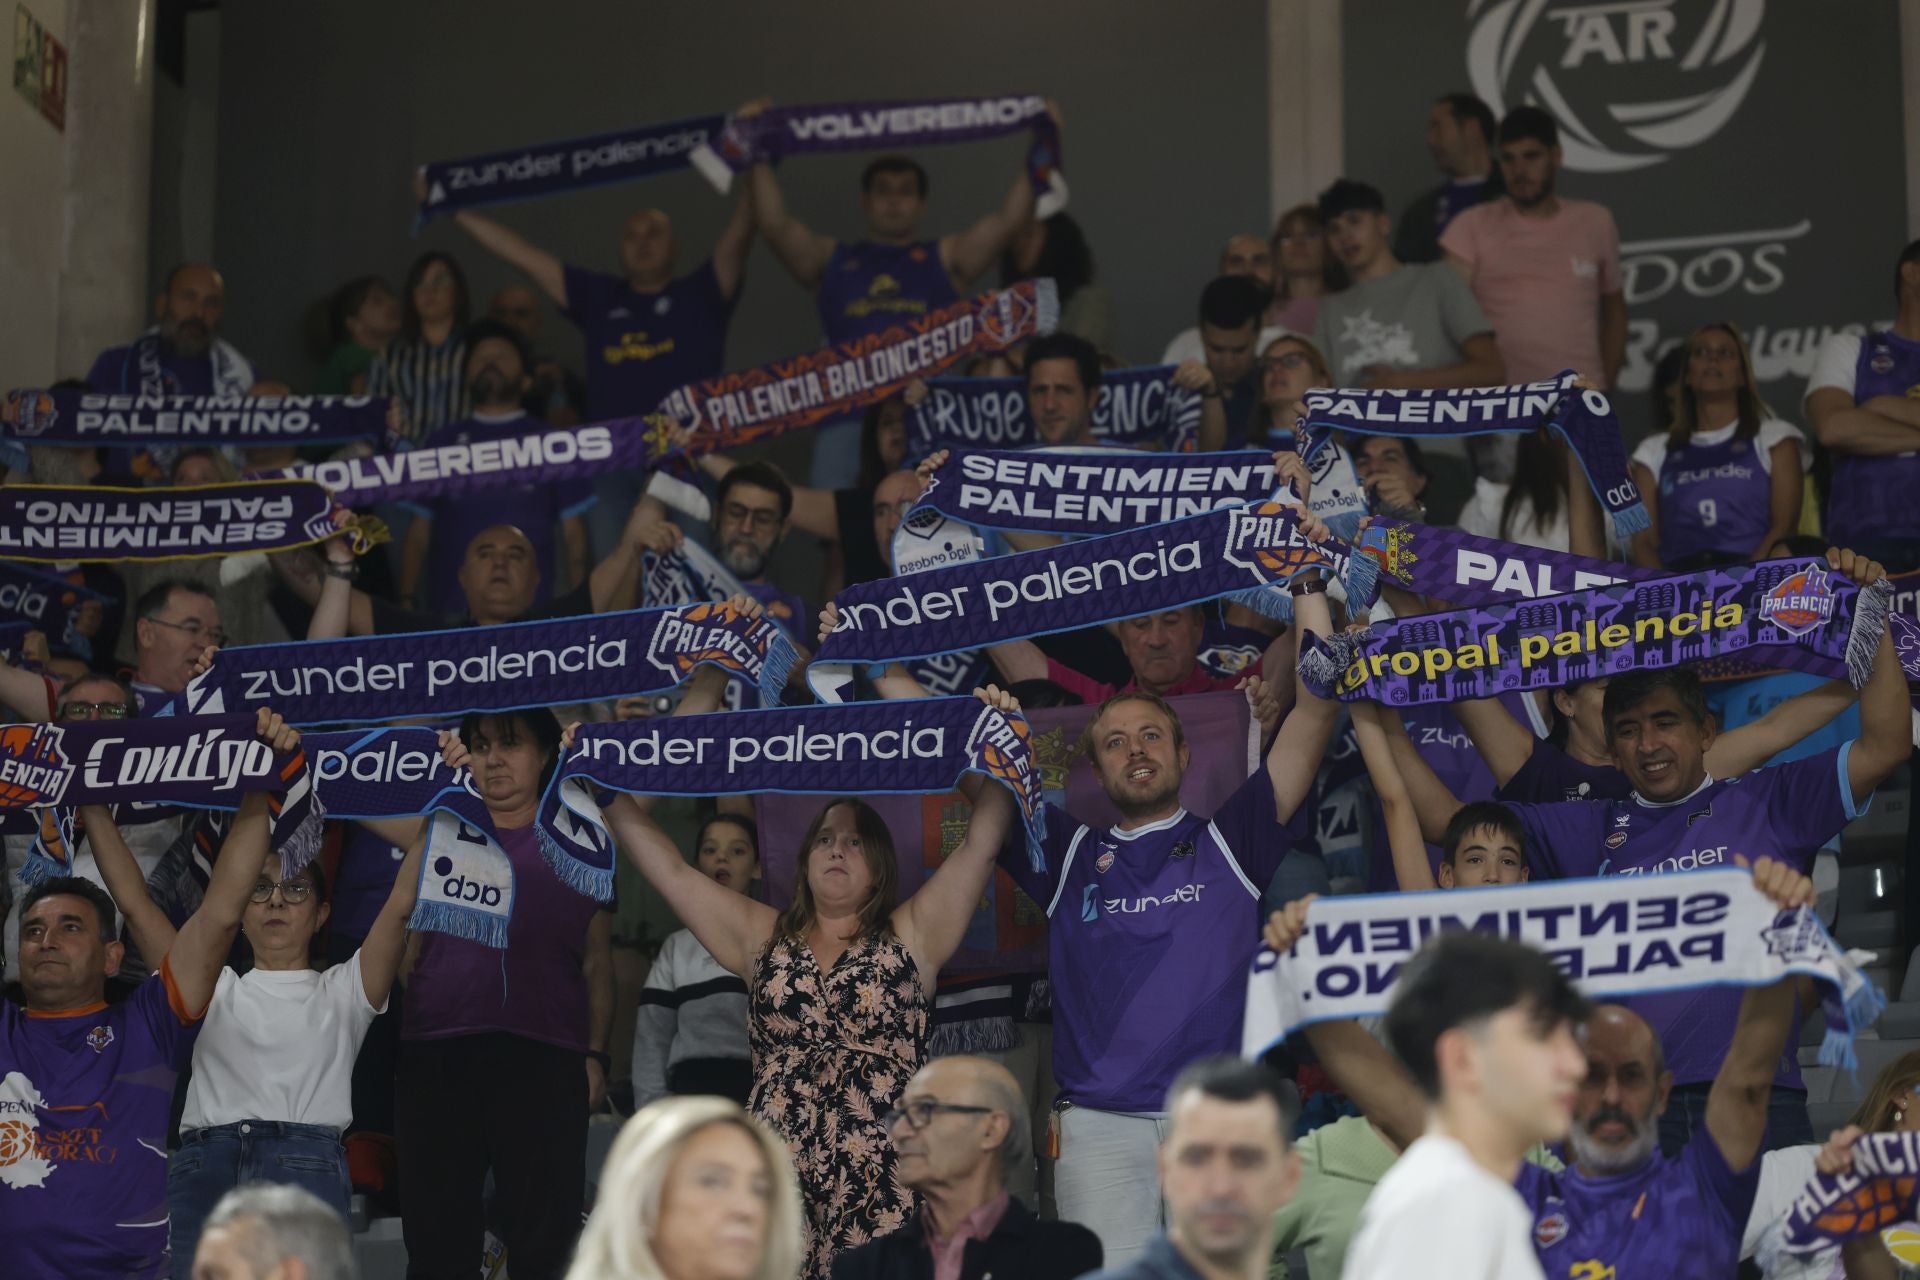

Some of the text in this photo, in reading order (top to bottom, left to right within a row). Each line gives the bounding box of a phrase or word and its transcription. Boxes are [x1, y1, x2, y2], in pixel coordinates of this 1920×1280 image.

[788, 97, 1046, 140] VOLVEREMOS
[448, 128, 709, 190] zunder palencia
[1622, 244, 1787, 304] DOS
[706, 375, 825, 433] PALENCIA
[826, 314, 974, 398] BALONCESTO
[76, 410, 320, 435] PALENTINO.
[1676, 460, 1752, 485] zunder
[15, 495, 294, 526] PALENTINO.
[1699, 498, 1718, 527] 9
[0, 521, 287, 549] SENTIMIENT
[831, 540, 1201, 633] under palencia
[1765, 595, 1831, 616] PALENCIA
[658, 619, 764, 681] PALENCIA
[1520, 600, 1743, 668] palencia
[241, 632, 626, 701] zunder palencia
[567, 720, 944, 774] under palencia
[1104, 883, 1206, 914] zunder
